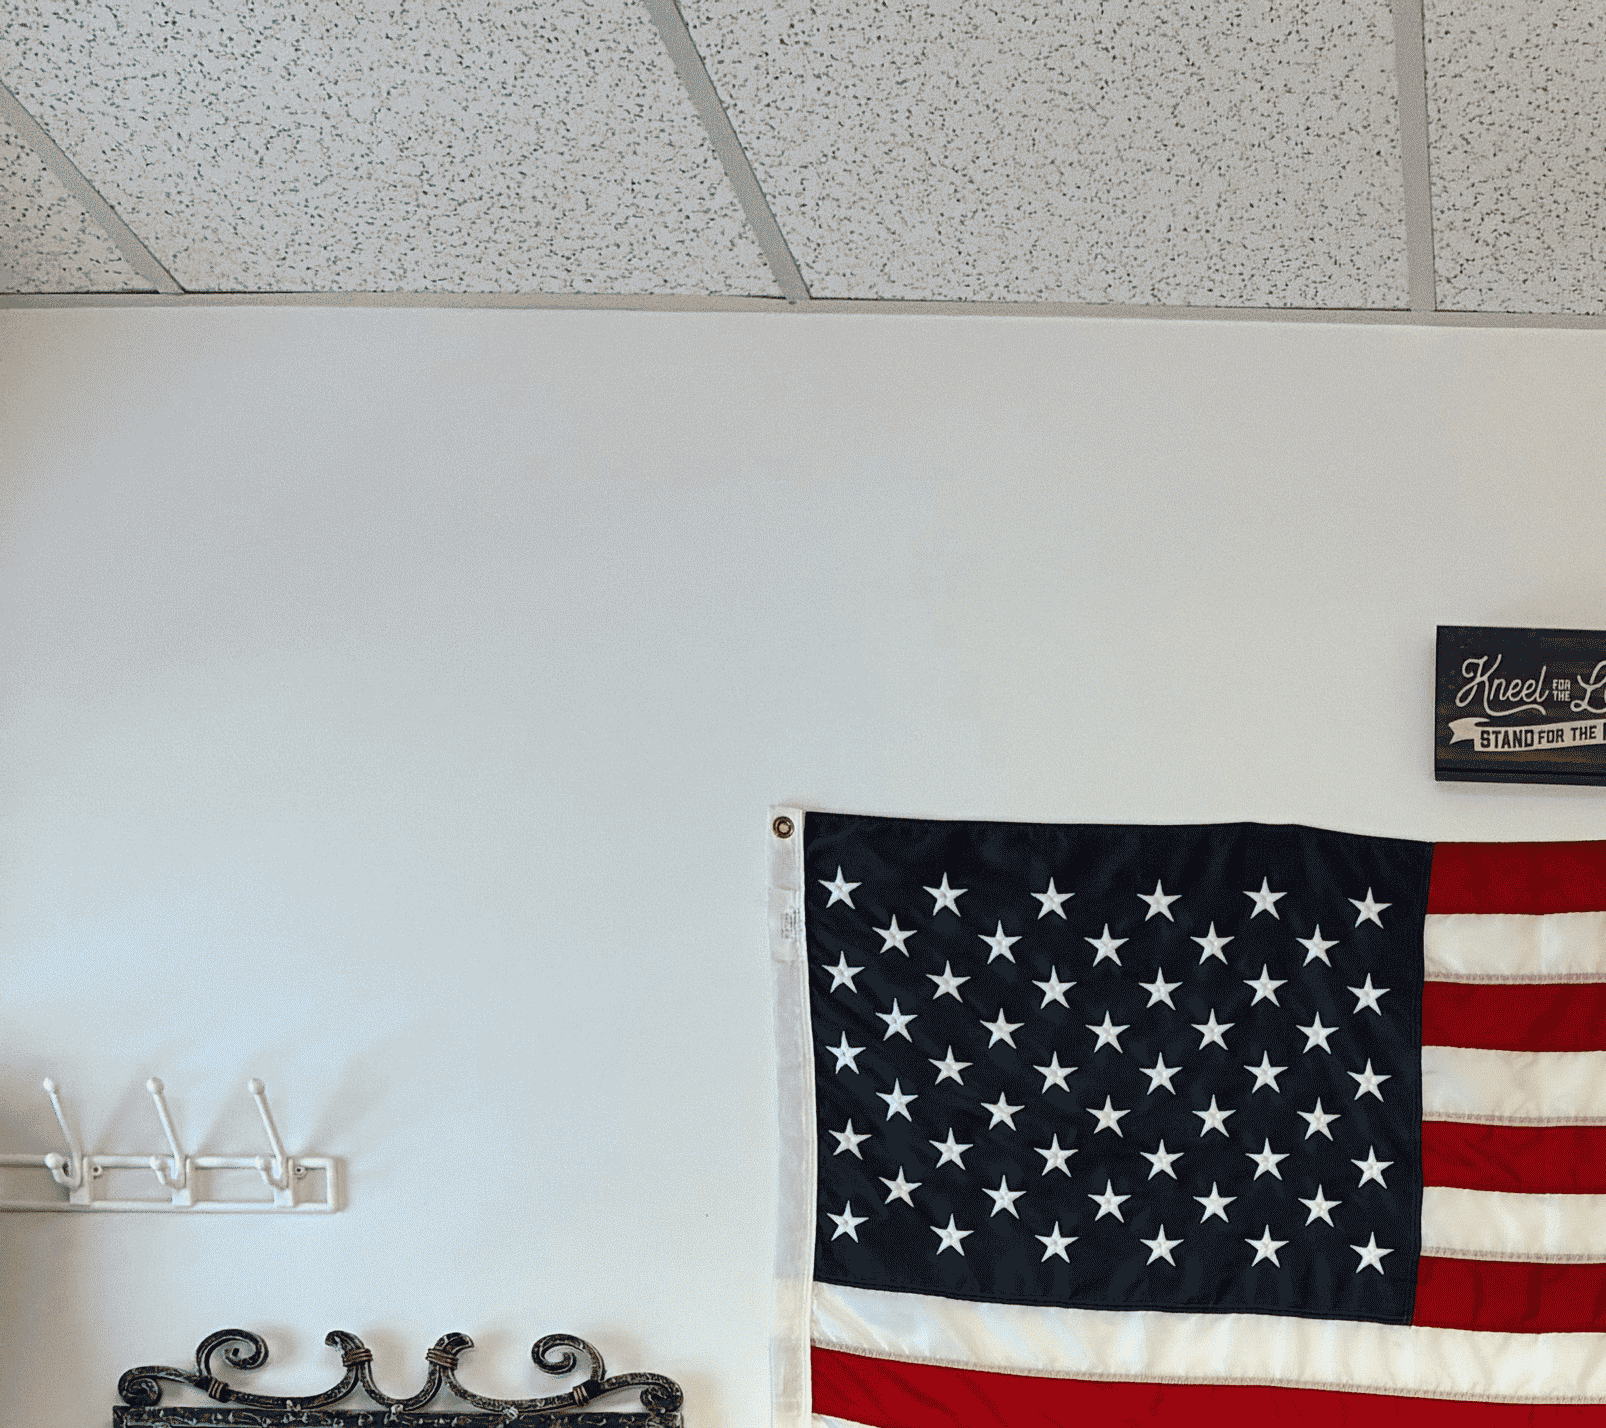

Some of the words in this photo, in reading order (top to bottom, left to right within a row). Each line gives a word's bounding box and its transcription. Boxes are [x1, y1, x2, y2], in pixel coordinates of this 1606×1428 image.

[1455, 653, 1548, 716] Kneel
[1552, 679, 1571, 691] FOR
[1552, 690, 1571, 702] THE
[1480, 729, 1534, 749] STAND
[1538, 728, 1564, 745] FOR
[1570, 725, 1597, 742] THE
